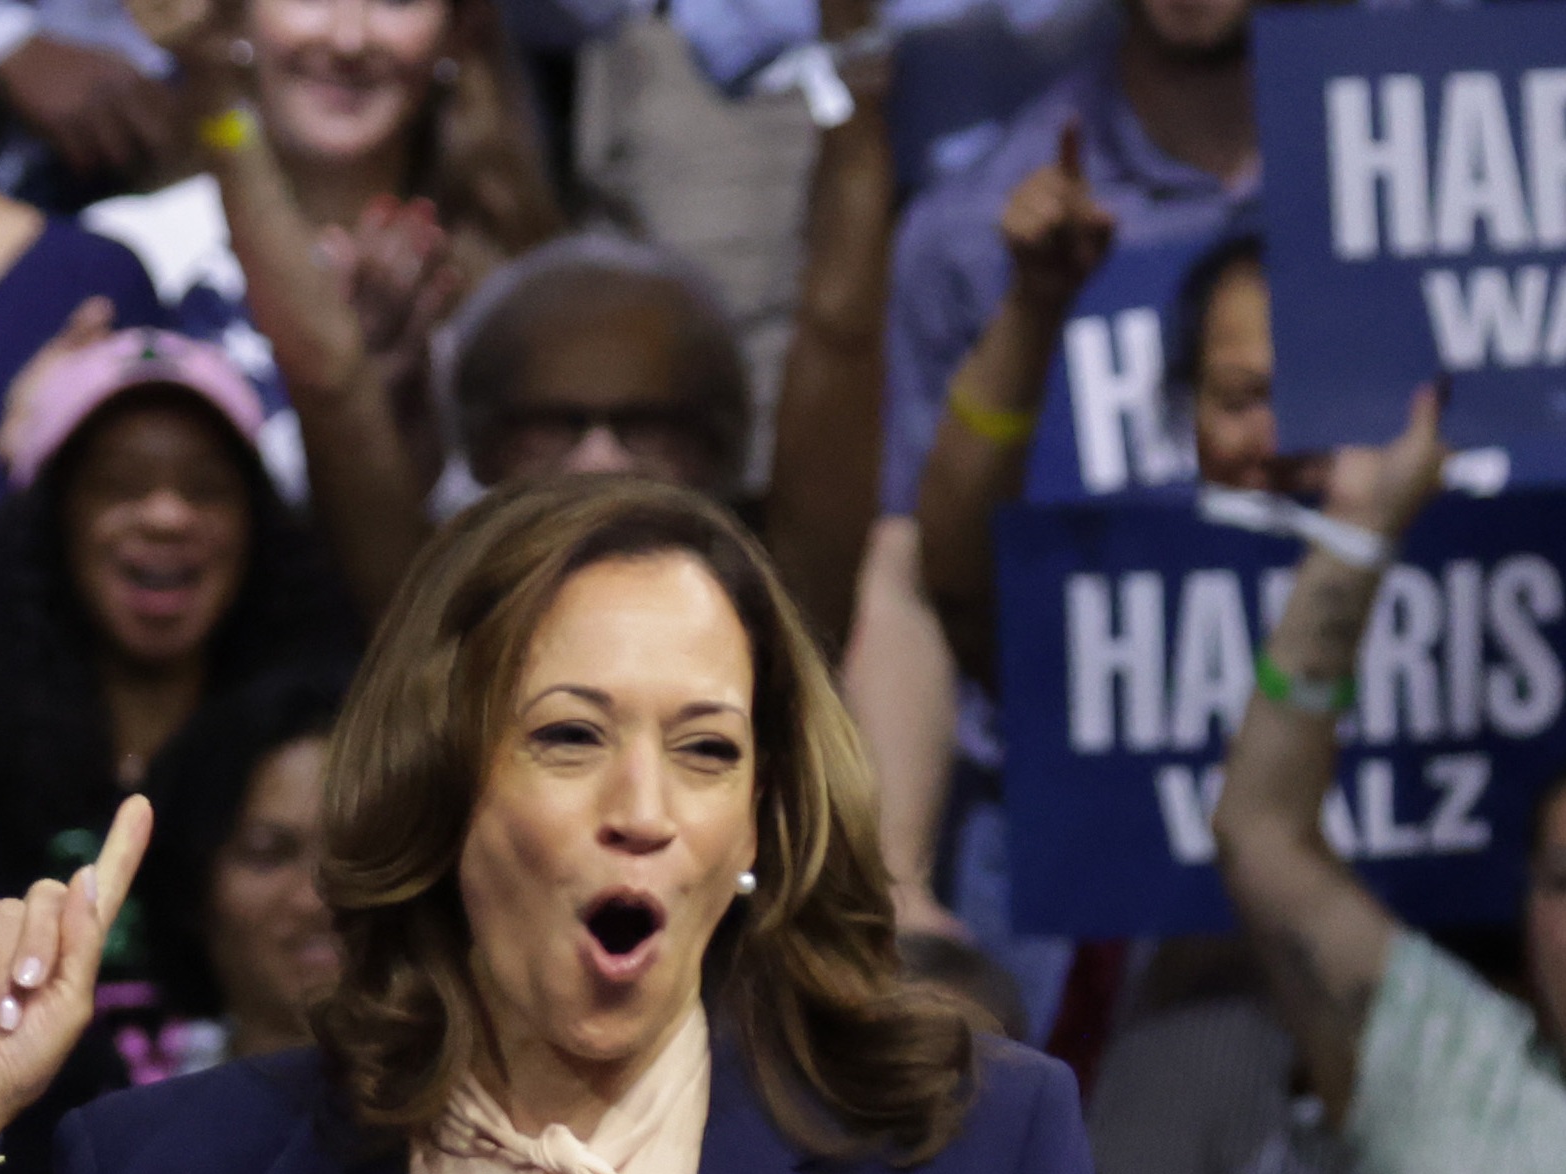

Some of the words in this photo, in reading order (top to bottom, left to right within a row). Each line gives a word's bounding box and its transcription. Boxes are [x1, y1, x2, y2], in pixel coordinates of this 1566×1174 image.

[1064, 307, 1199, 495] H
[1420, 264, 1566, 370] W
[1064, 553, 1565, 755] HARIS
